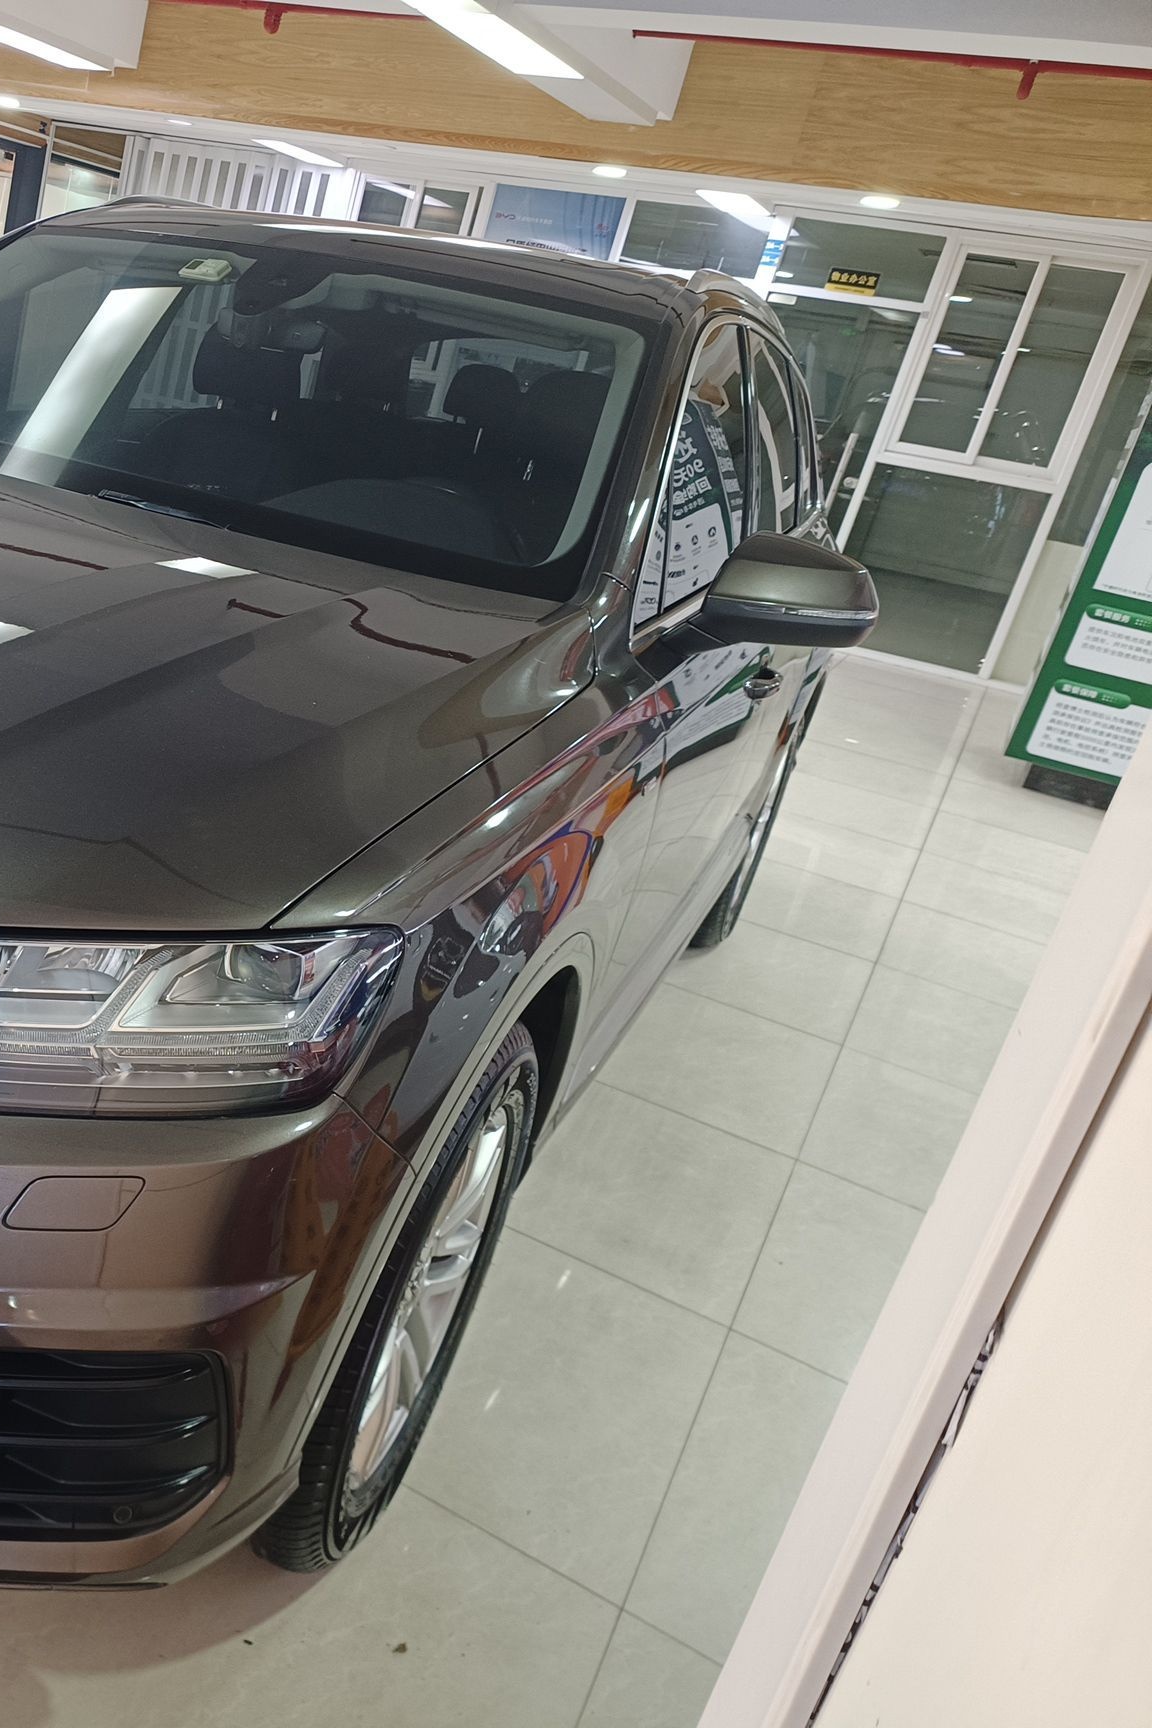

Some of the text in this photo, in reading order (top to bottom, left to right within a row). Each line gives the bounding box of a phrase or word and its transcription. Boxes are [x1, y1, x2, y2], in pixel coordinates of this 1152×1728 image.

[831, 271, 878, 287] 物业办公室
